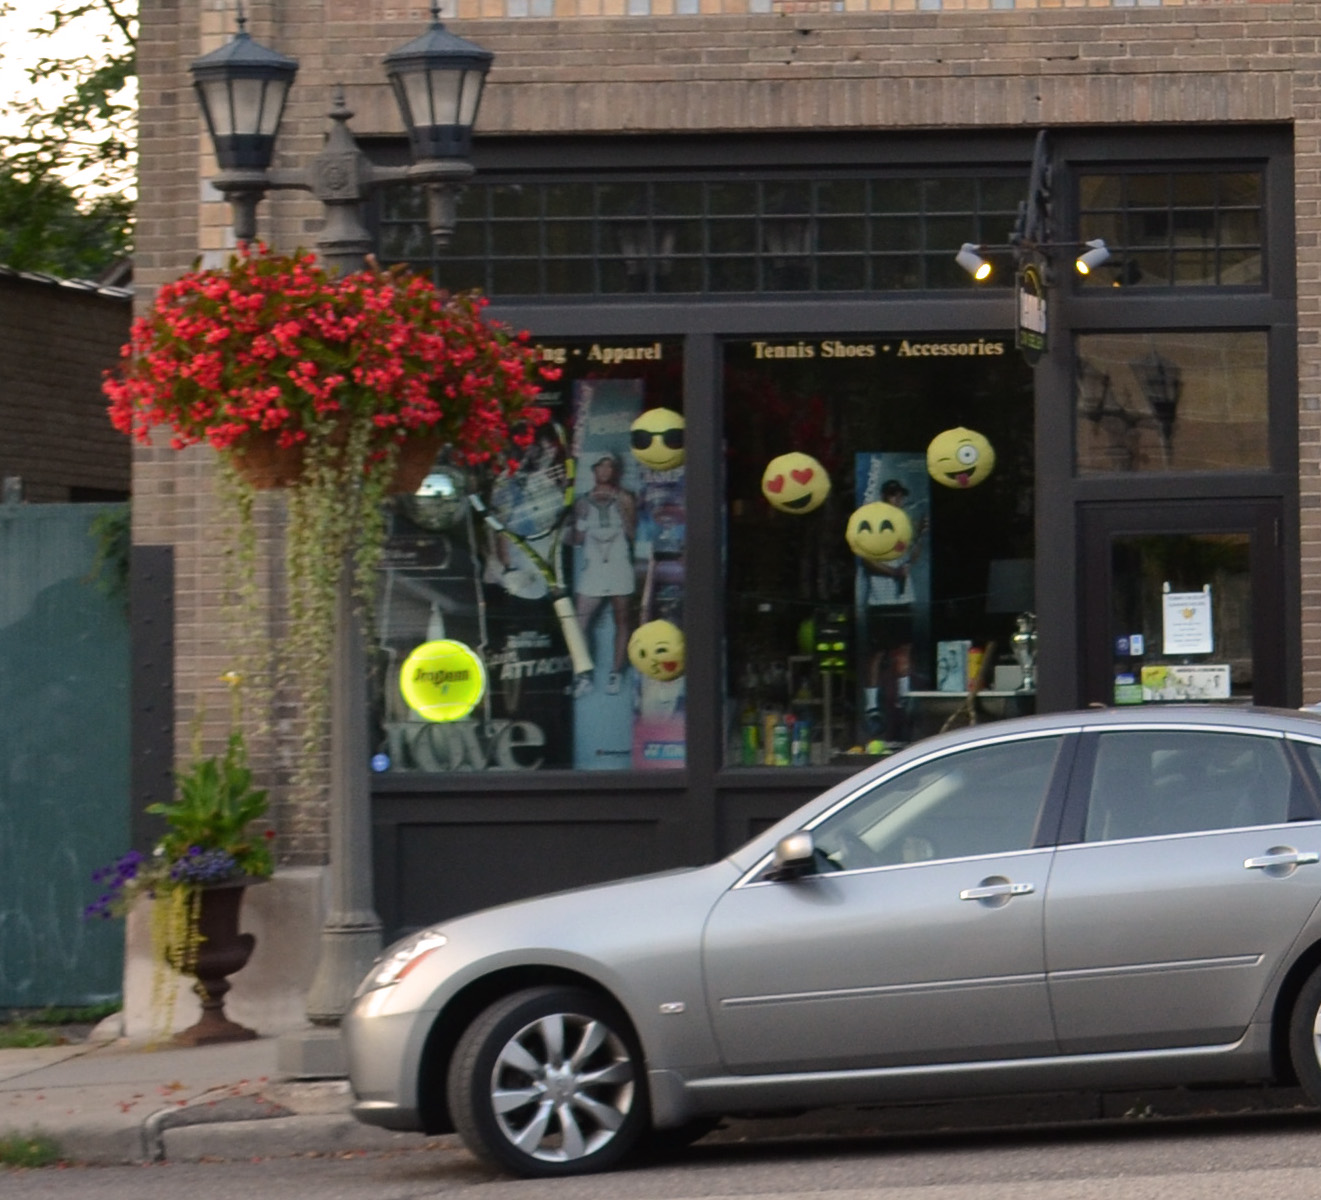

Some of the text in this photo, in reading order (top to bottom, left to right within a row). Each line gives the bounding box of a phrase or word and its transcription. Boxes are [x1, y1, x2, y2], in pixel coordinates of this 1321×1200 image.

[587, 342, 663, 364] Apparel
[752, 341, 814, 359] Tennis
[821, 340, 875, 358] Shoes
[898, 338, 1004, 357] Accessories
